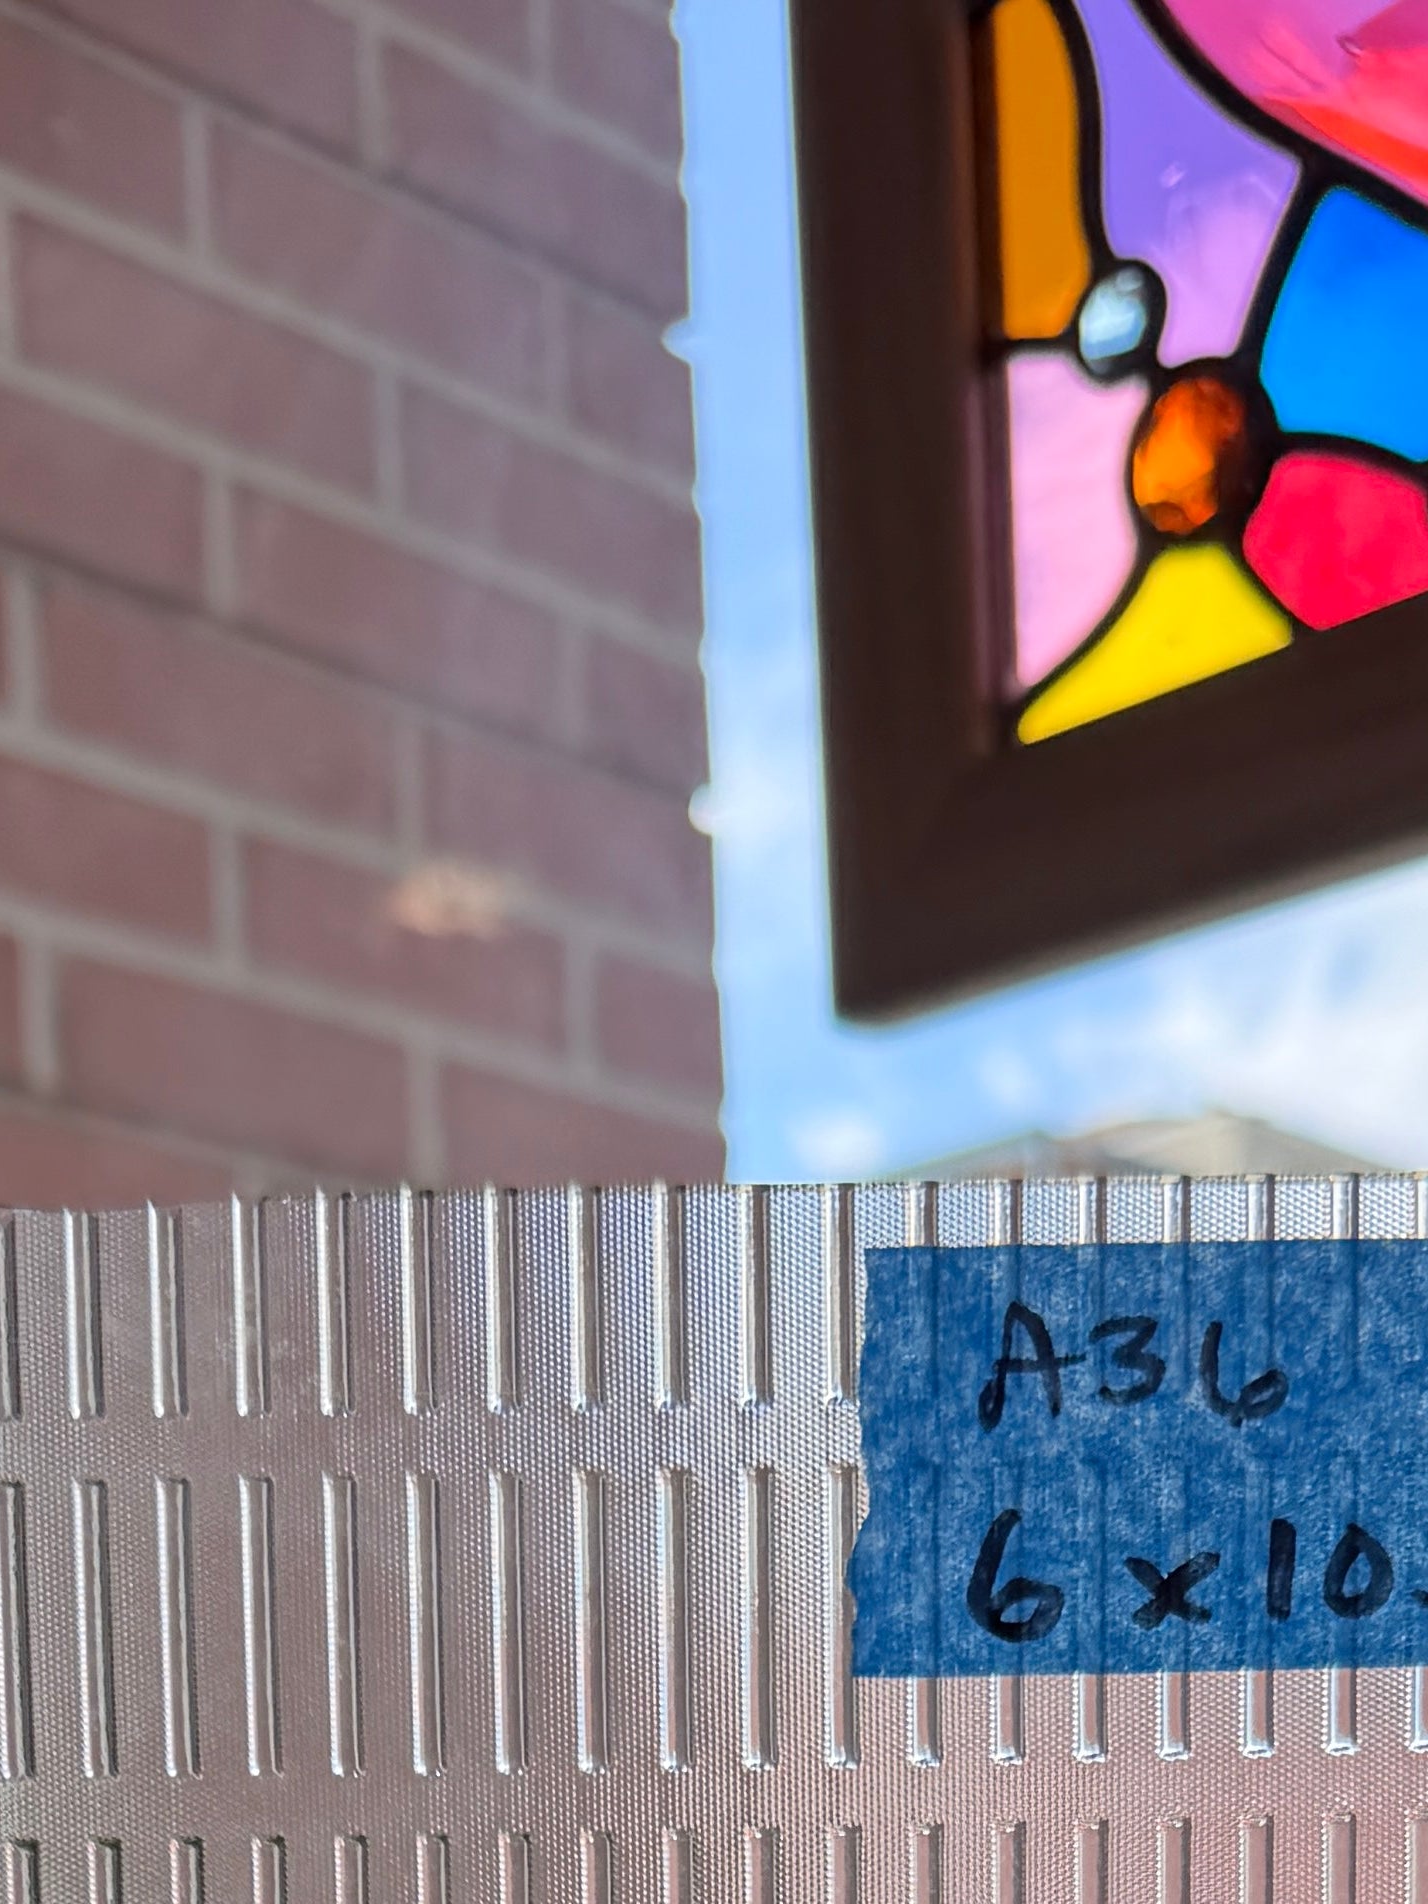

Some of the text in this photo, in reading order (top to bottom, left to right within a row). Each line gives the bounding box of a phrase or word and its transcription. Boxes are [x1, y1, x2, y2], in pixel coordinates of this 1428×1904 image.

[977, 1301, 1291, 1431] A36
[967, 1508, 1065, 1643] 6
[1124, 1552, 1221, 1630] x
